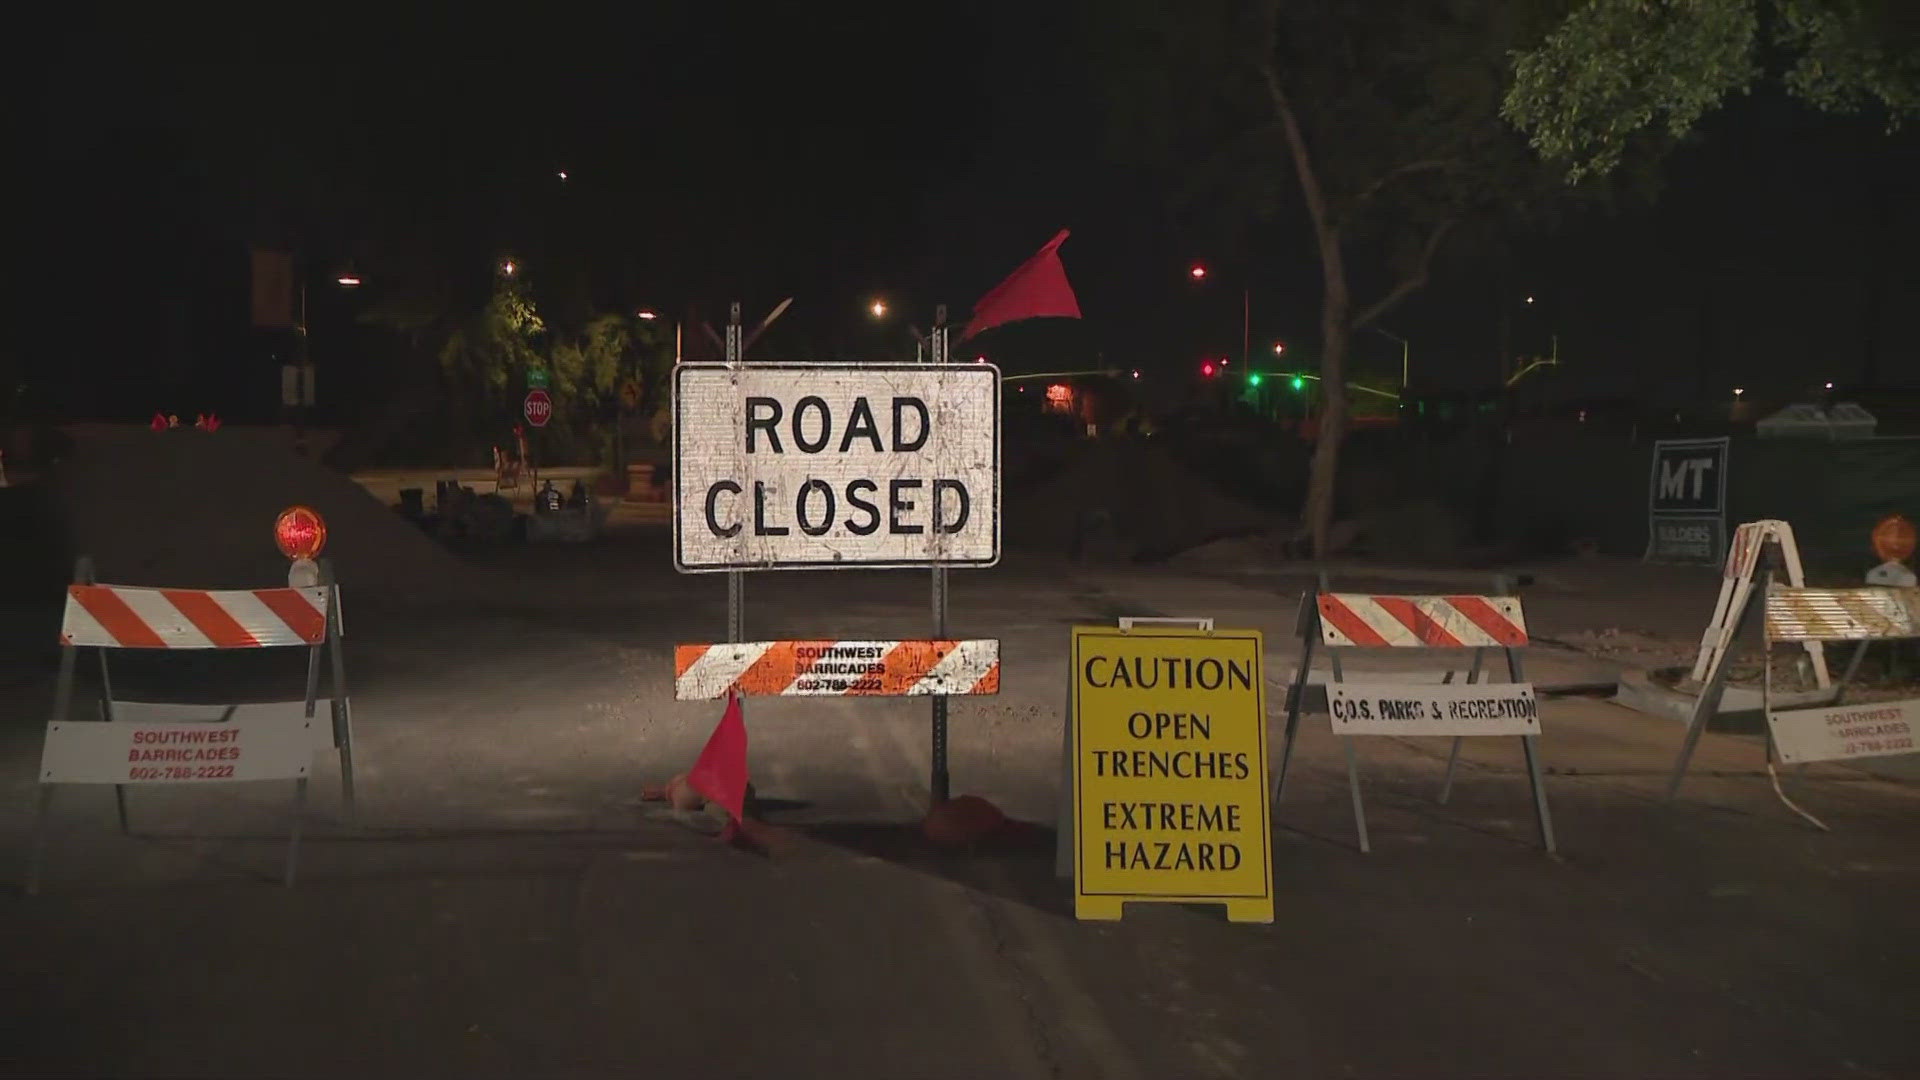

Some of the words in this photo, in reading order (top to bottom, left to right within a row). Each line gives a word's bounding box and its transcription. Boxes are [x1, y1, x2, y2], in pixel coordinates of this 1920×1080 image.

[526, 401, 549, 416] STOP
[745, 396, 930, 453] ROAD
[1659, 458, 1713, 500] MT
[705, 479, 970, 537] CLOSED
[796, 647, 884, 658] SOUTHWEST
[795, 662, 886, 674] BARRICADES
[1085, 656, 1251, 690] CAUTION
[1431, 701, 1443, 720] &
[1448, 698, 1537, 720] RECREATION
[133, 729, 239, 744] SOUTHWEST
[1128, 712, 1210, 740] OPEN
[128, 746, 240, 762] BARRICADES
[1092, 751, 1249, 780] TRENCHES
[129, 765, 234, 780] 602-788-2222
[1103, 803, 1241, 832] EXTREME
[1105, 841, 1241, 871] HAZARD
